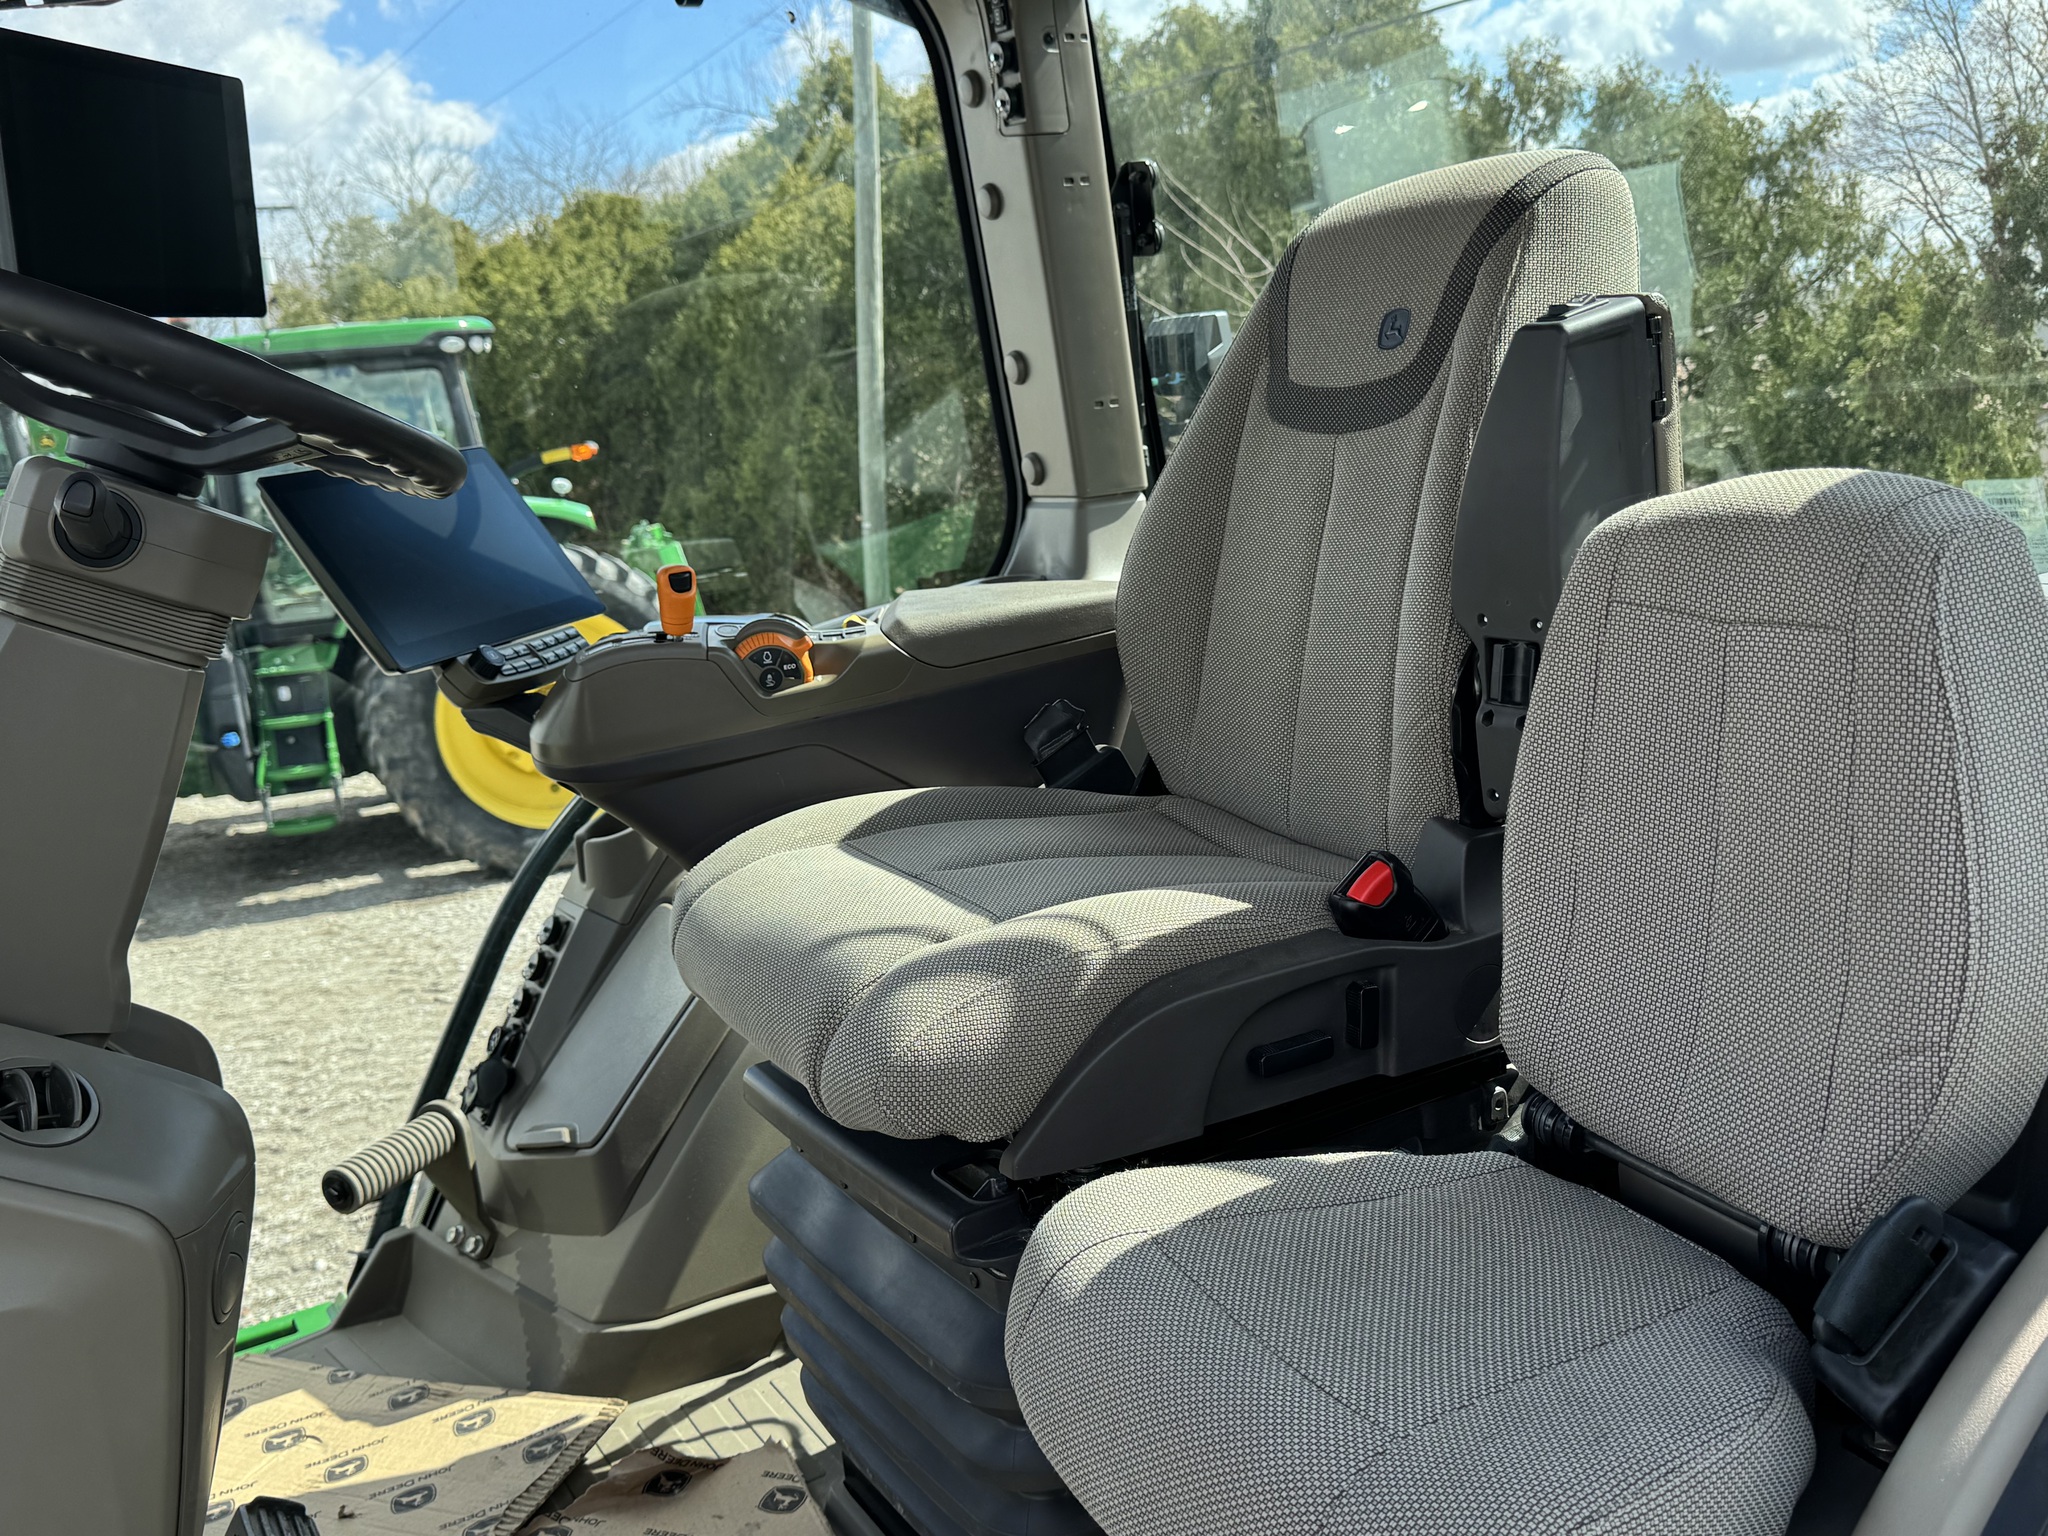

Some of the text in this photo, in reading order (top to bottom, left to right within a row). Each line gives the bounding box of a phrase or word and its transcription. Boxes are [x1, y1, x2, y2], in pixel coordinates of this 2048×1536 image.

[783, 663, 797, 671] ECO
[231, 1380, 266, 1394] JOHN
[432, 1404, 475, 1424] DEERE
[244, 1412, 326, 1438] JOHN DEERE
[304, 1435, 389, 1469] JOHN DEERE
[219, 1480, 258, 1495] JOHN
[368, 1463, 456, 1500] JOHN DEERE
[439, 1509, 486, 1530] DEERE
